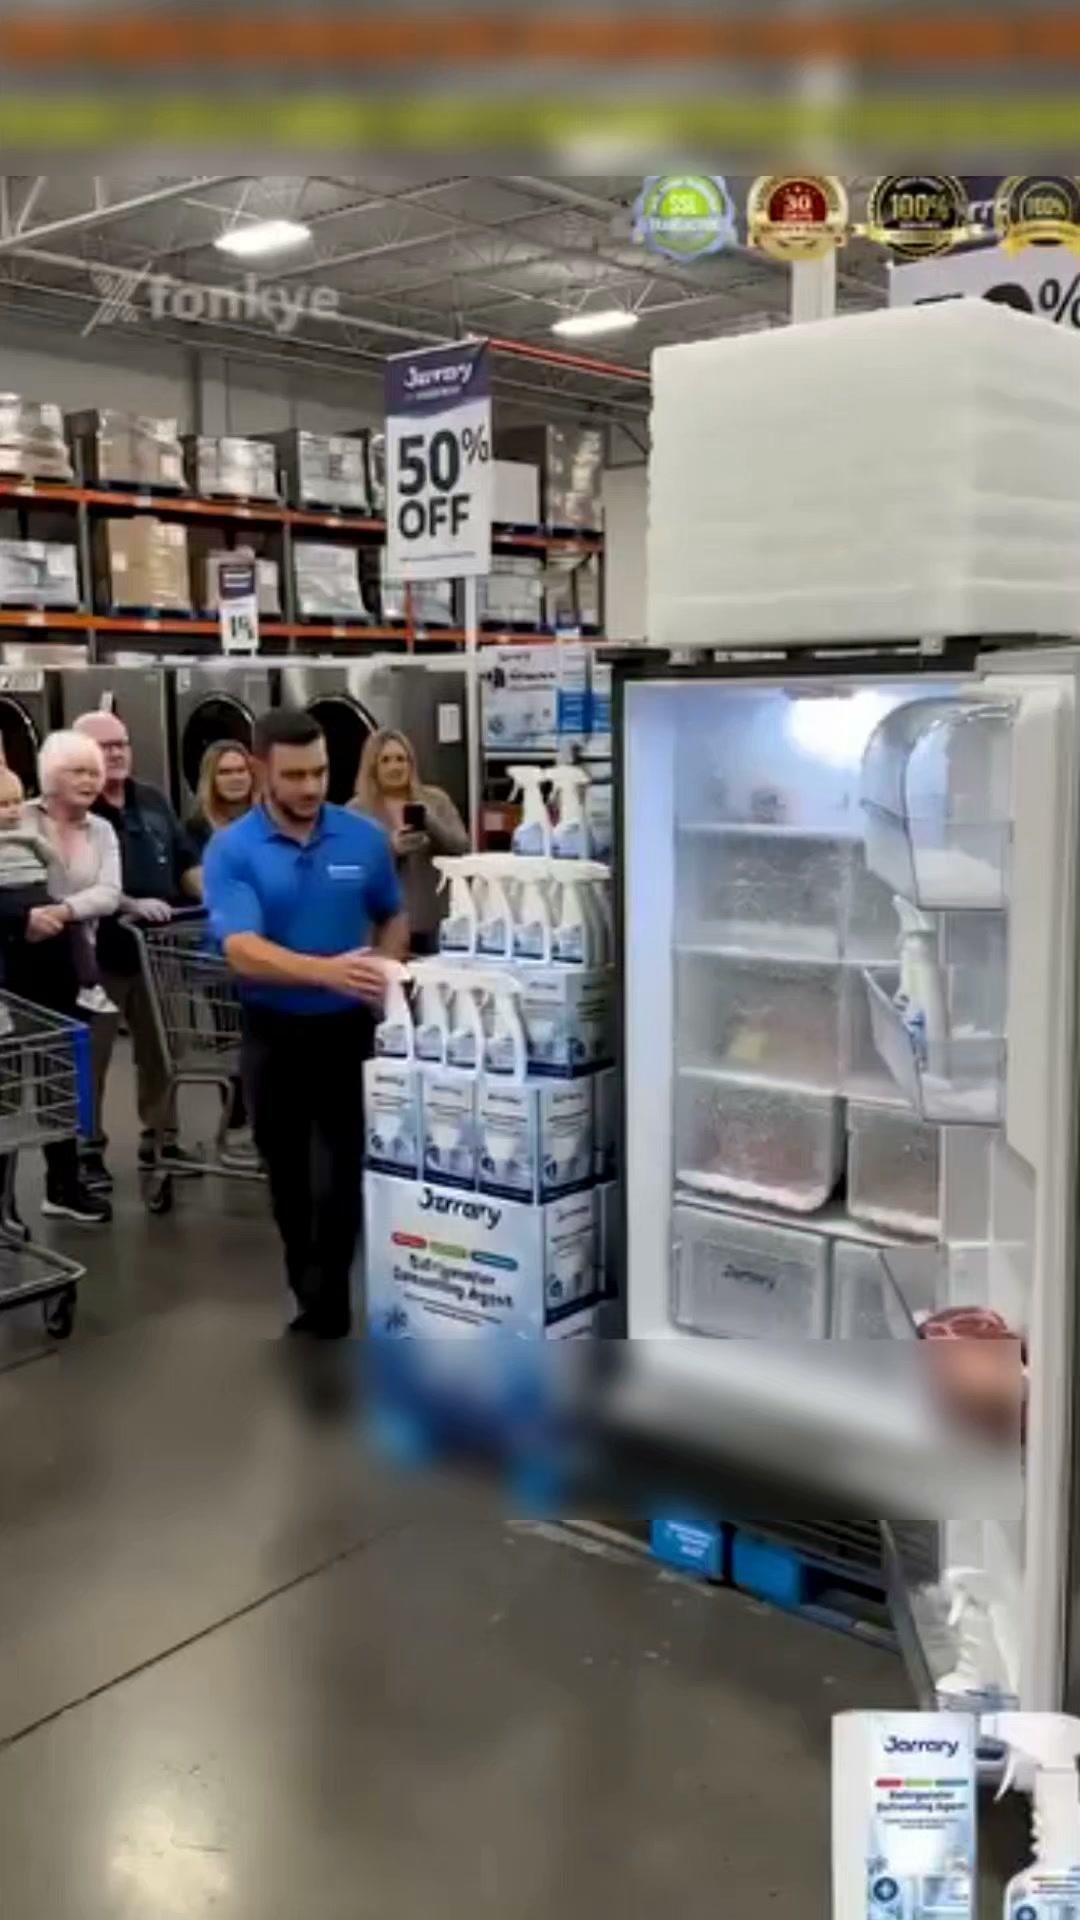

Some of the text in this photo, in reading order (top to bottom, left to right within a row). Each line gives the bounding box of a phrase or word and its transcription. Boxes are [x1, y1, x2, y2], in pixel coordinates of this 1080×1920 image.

[398, 424, 490, 497] 50%
[398, 494, 471, 540] OFF
[883, 1735, 959, 1758] Jarrary
